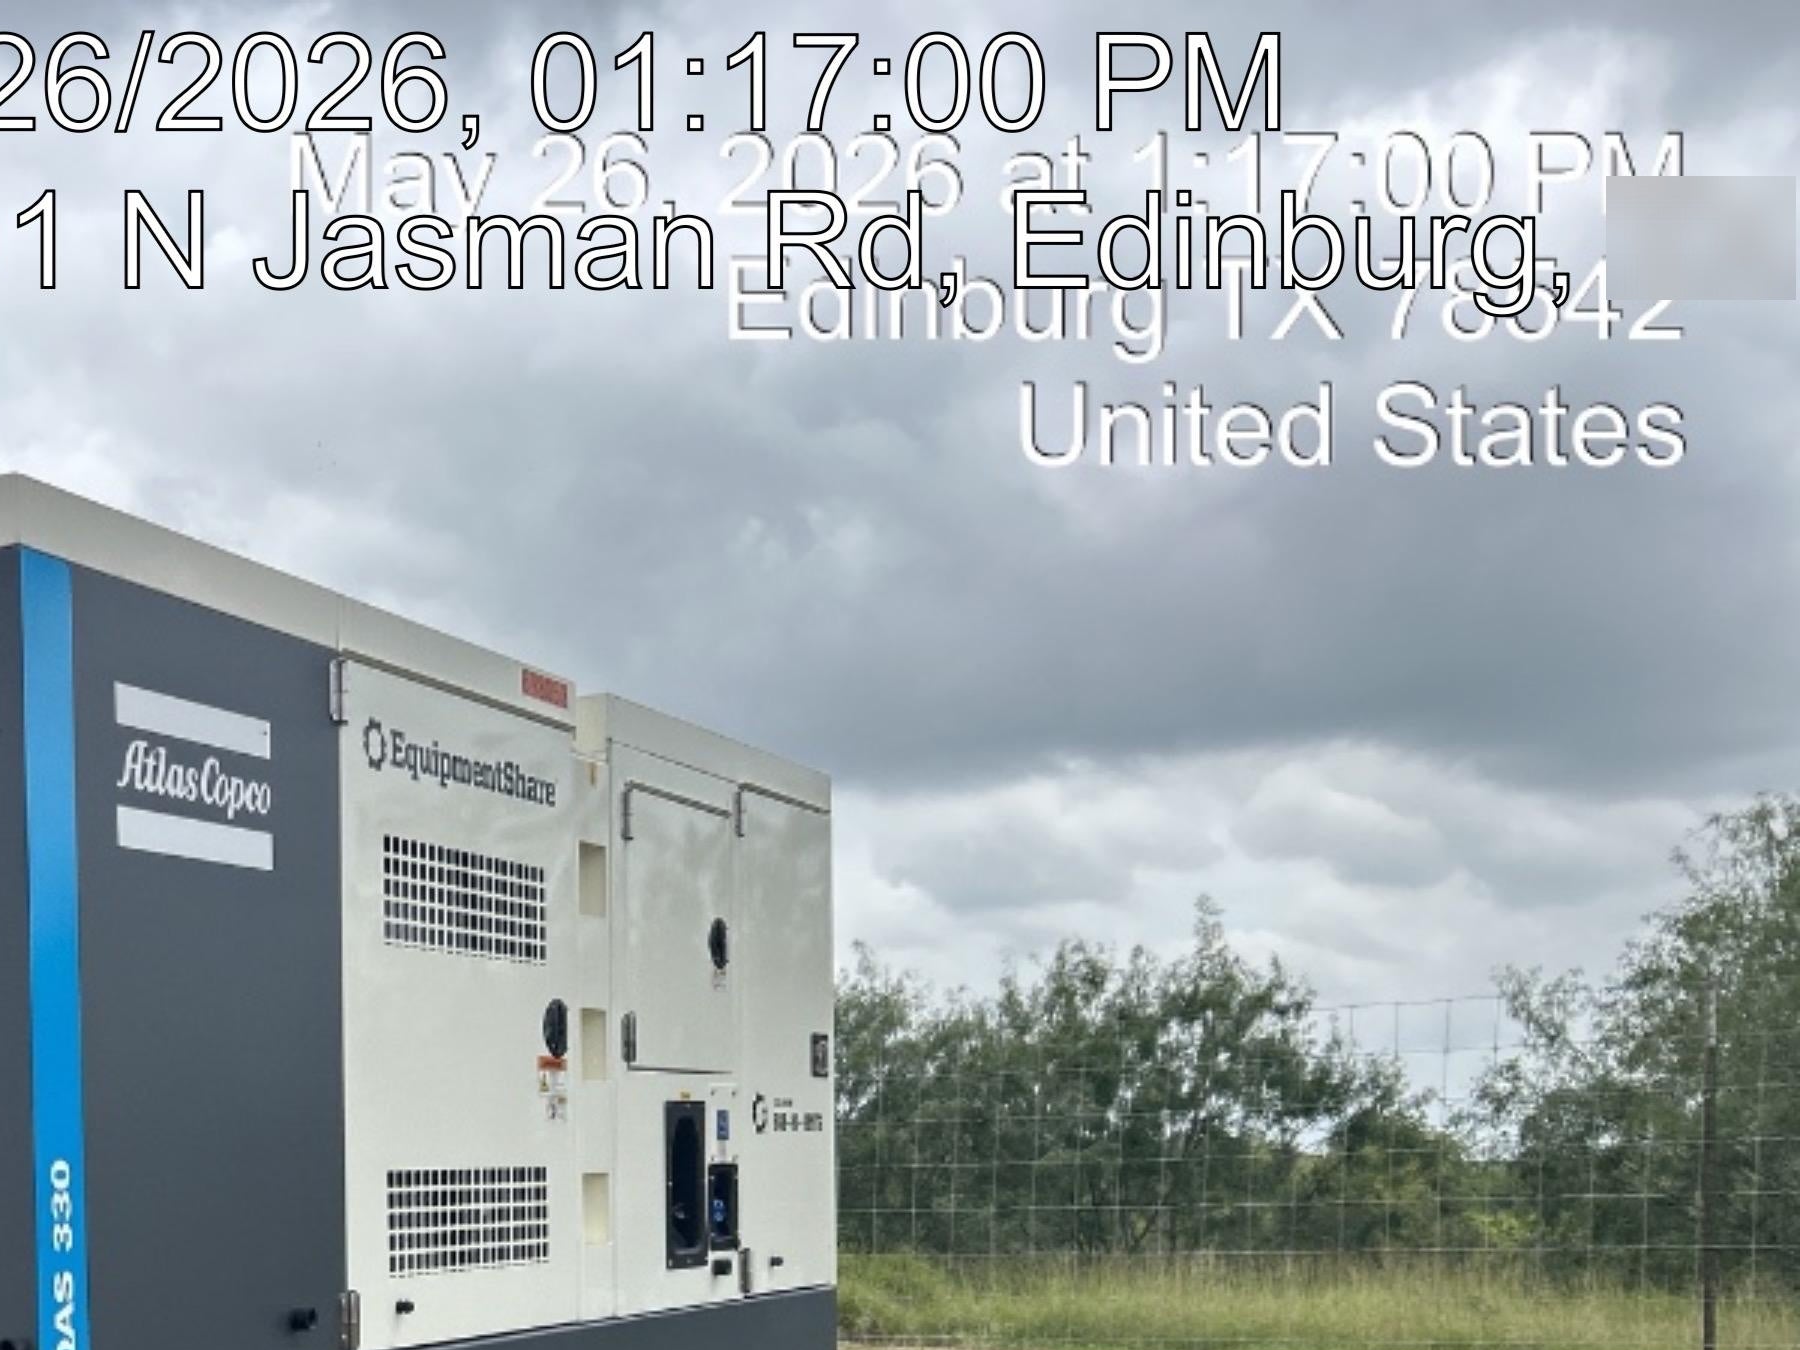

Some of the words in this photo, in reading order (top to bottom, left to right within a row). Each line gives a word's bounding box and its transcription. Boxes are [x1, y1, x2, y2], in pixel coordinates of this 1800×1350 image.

[117, 740, 200, 801] Atlas
[200, 757, 272, 819] Copco
[390, 728, 557, 806] EquipmentShare
[50, 1159, 73, 1253] 330
